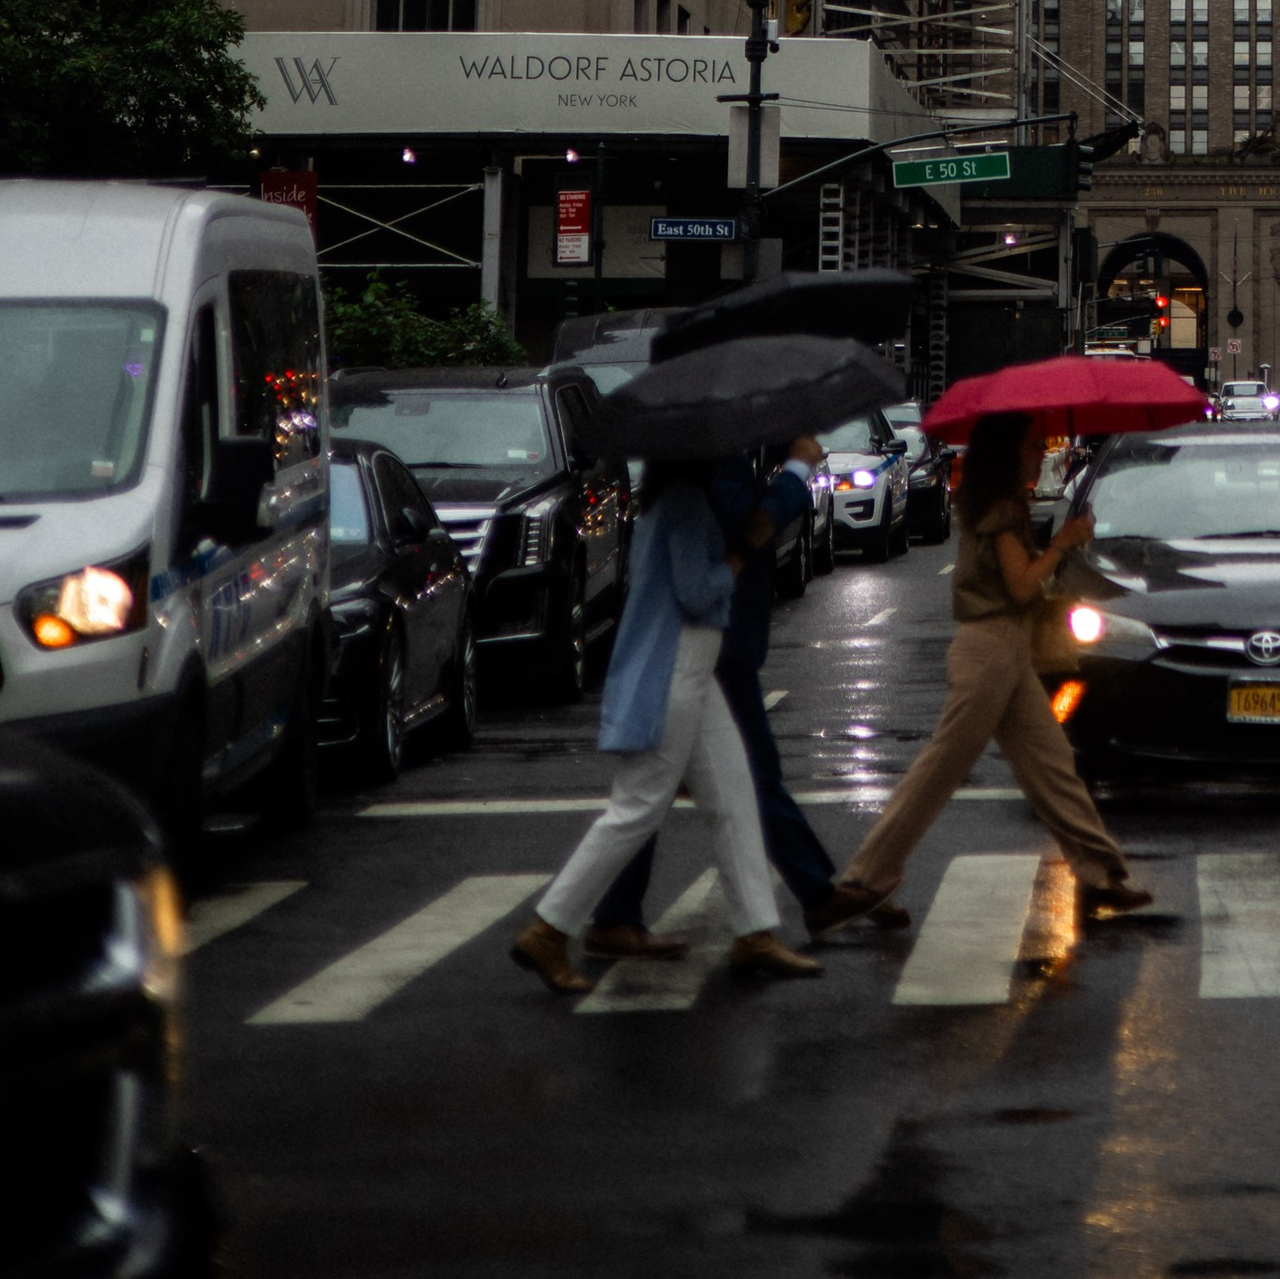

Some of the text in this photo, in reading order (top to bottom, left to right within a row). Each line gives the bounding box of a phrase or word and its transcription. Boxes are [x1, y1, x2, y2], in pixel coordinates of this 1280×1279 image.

[459, 56, 736, 84] WALDORF ASTORIA
[557, 94, 637, 108] NEW YORK
[925, 161, 977, 179] E 50 St
[260, 182, 306, 203] Inside
[657, 223, 684, 235] East
[686, 224, 713, 236] 50th
[716, 224, 729, 236] St
